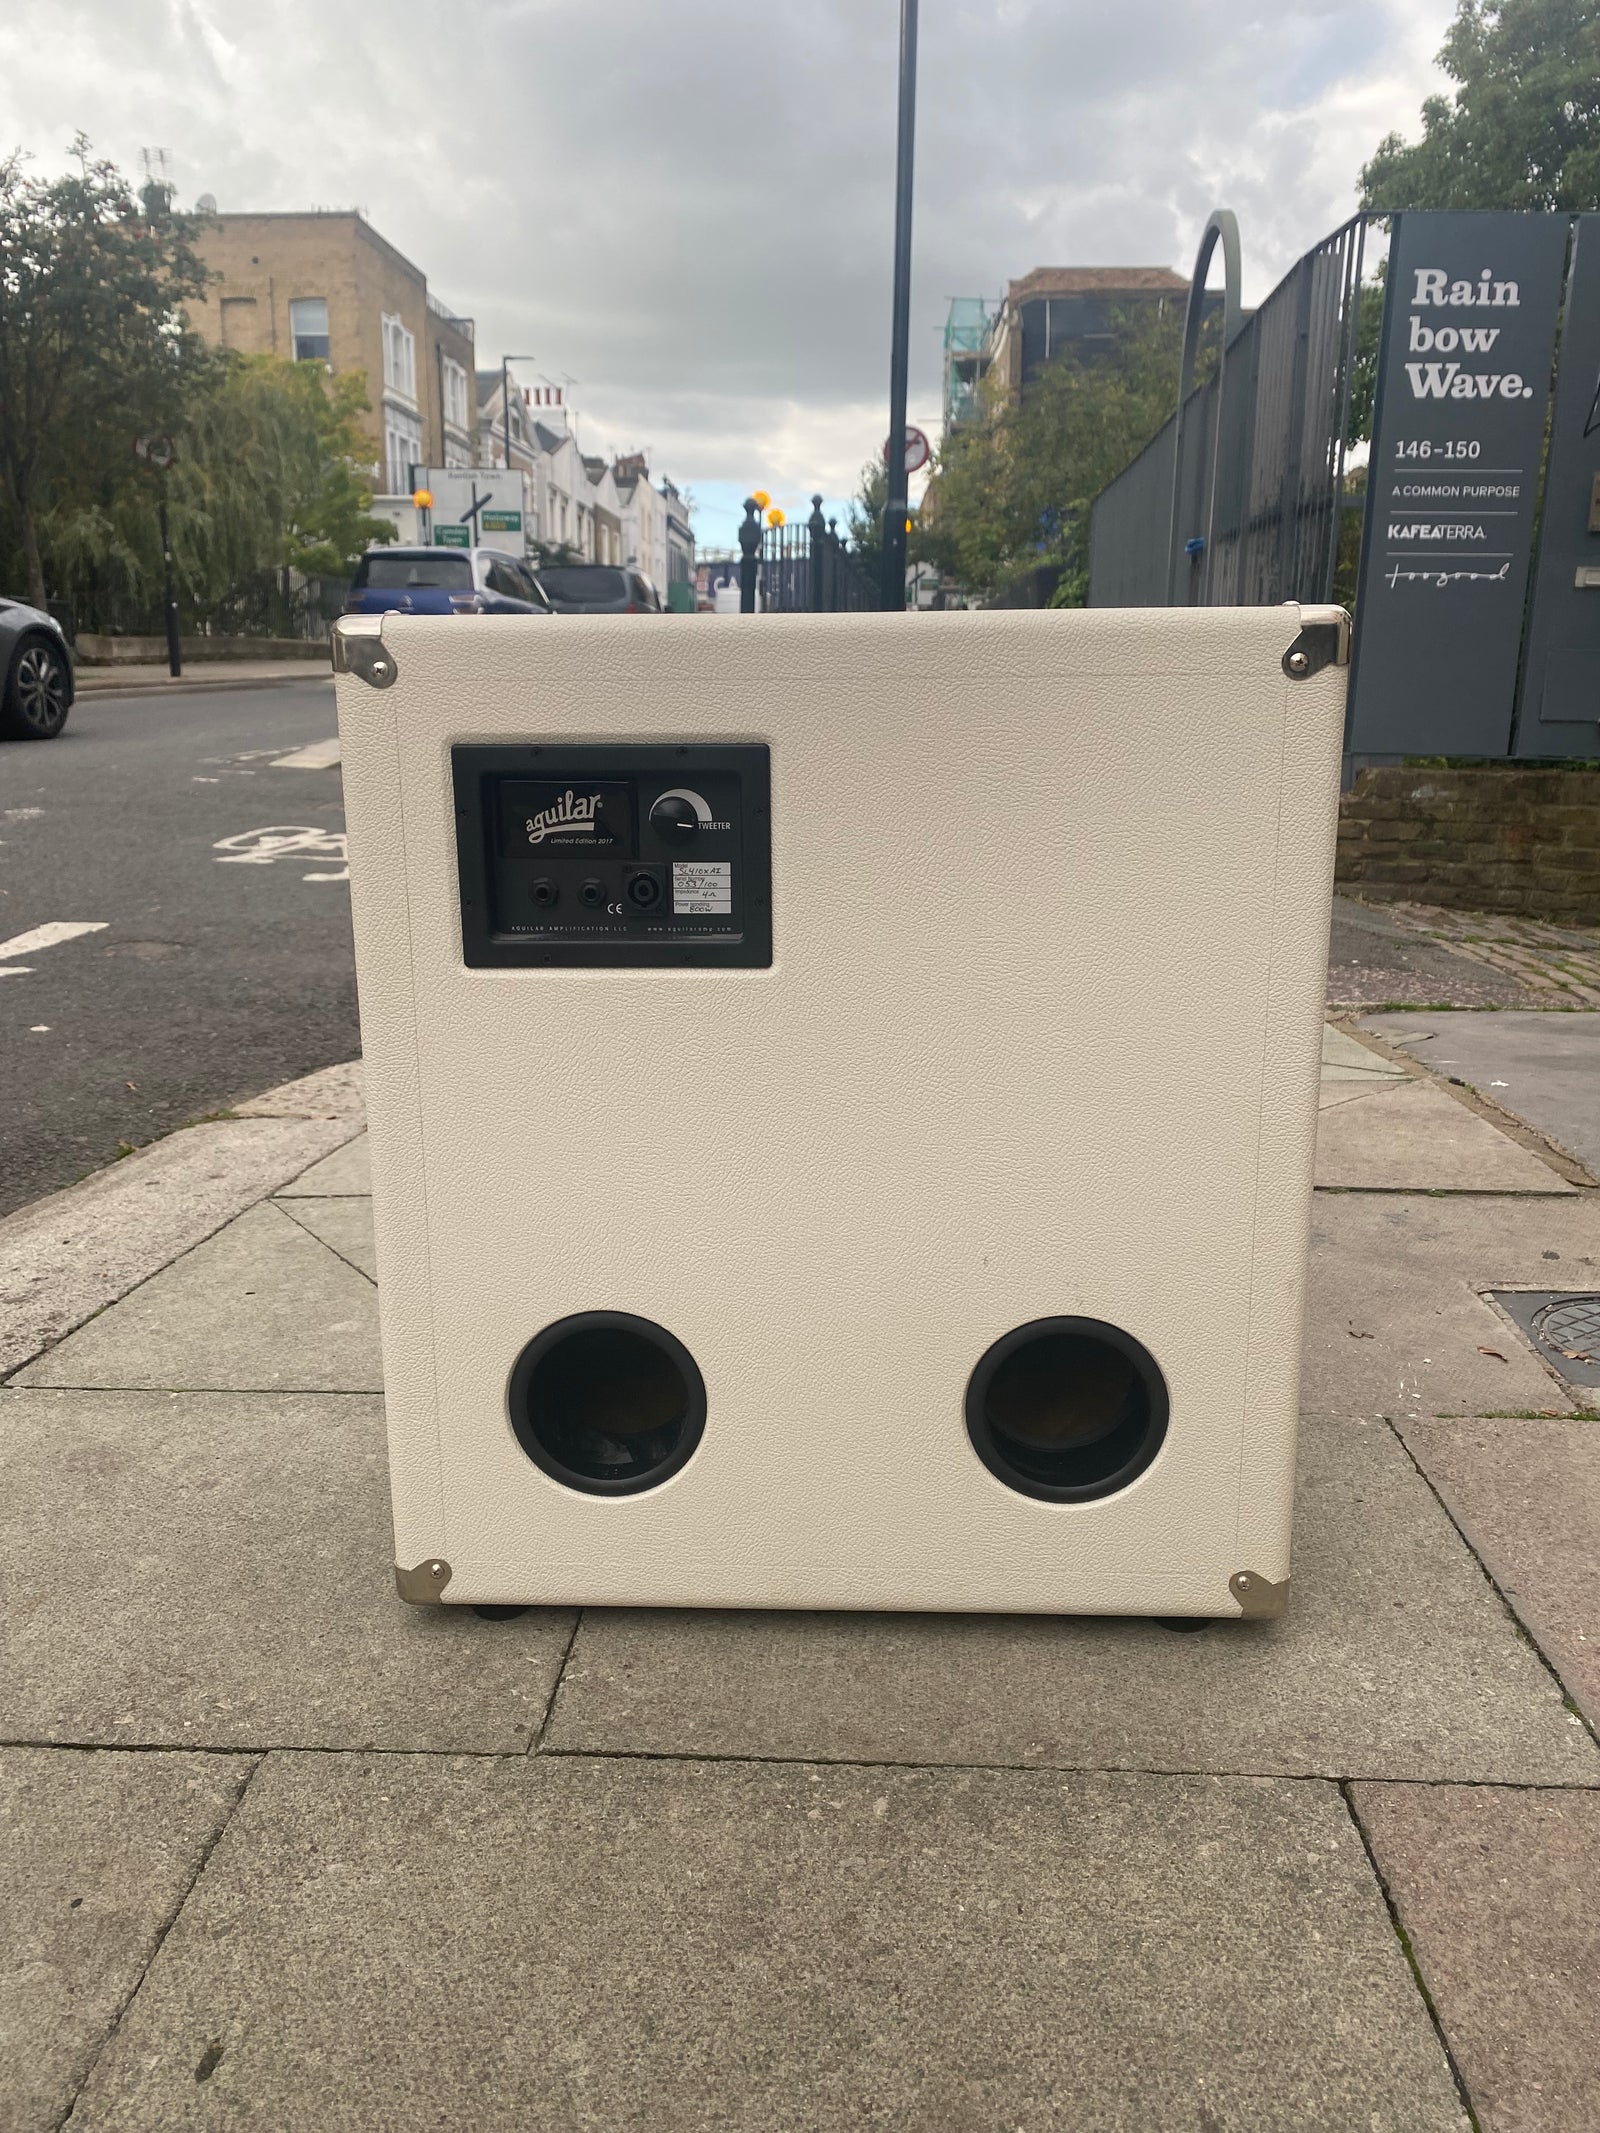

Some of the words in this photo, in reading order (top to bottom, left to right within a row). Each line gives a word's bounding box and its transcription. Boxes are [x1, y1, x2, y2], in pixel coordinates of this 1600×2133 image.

[1411, 268, 1520, 306] Rain
[1409, 315, 1500, 352] bow
[1405, 362, 1533, 398] Wave.
[1395, 440, 1481, 459] 146-150
[1392, 486, 1400, 497] A
[1403, 485, 1459, 497] COMMON
[1463, 486, 1520, 497] PURPOSE
[1385, 562, 1510, 589] toogood
[525, 790, 601, 844] aguilar
[698, 822, 731, 830] TWEETER
